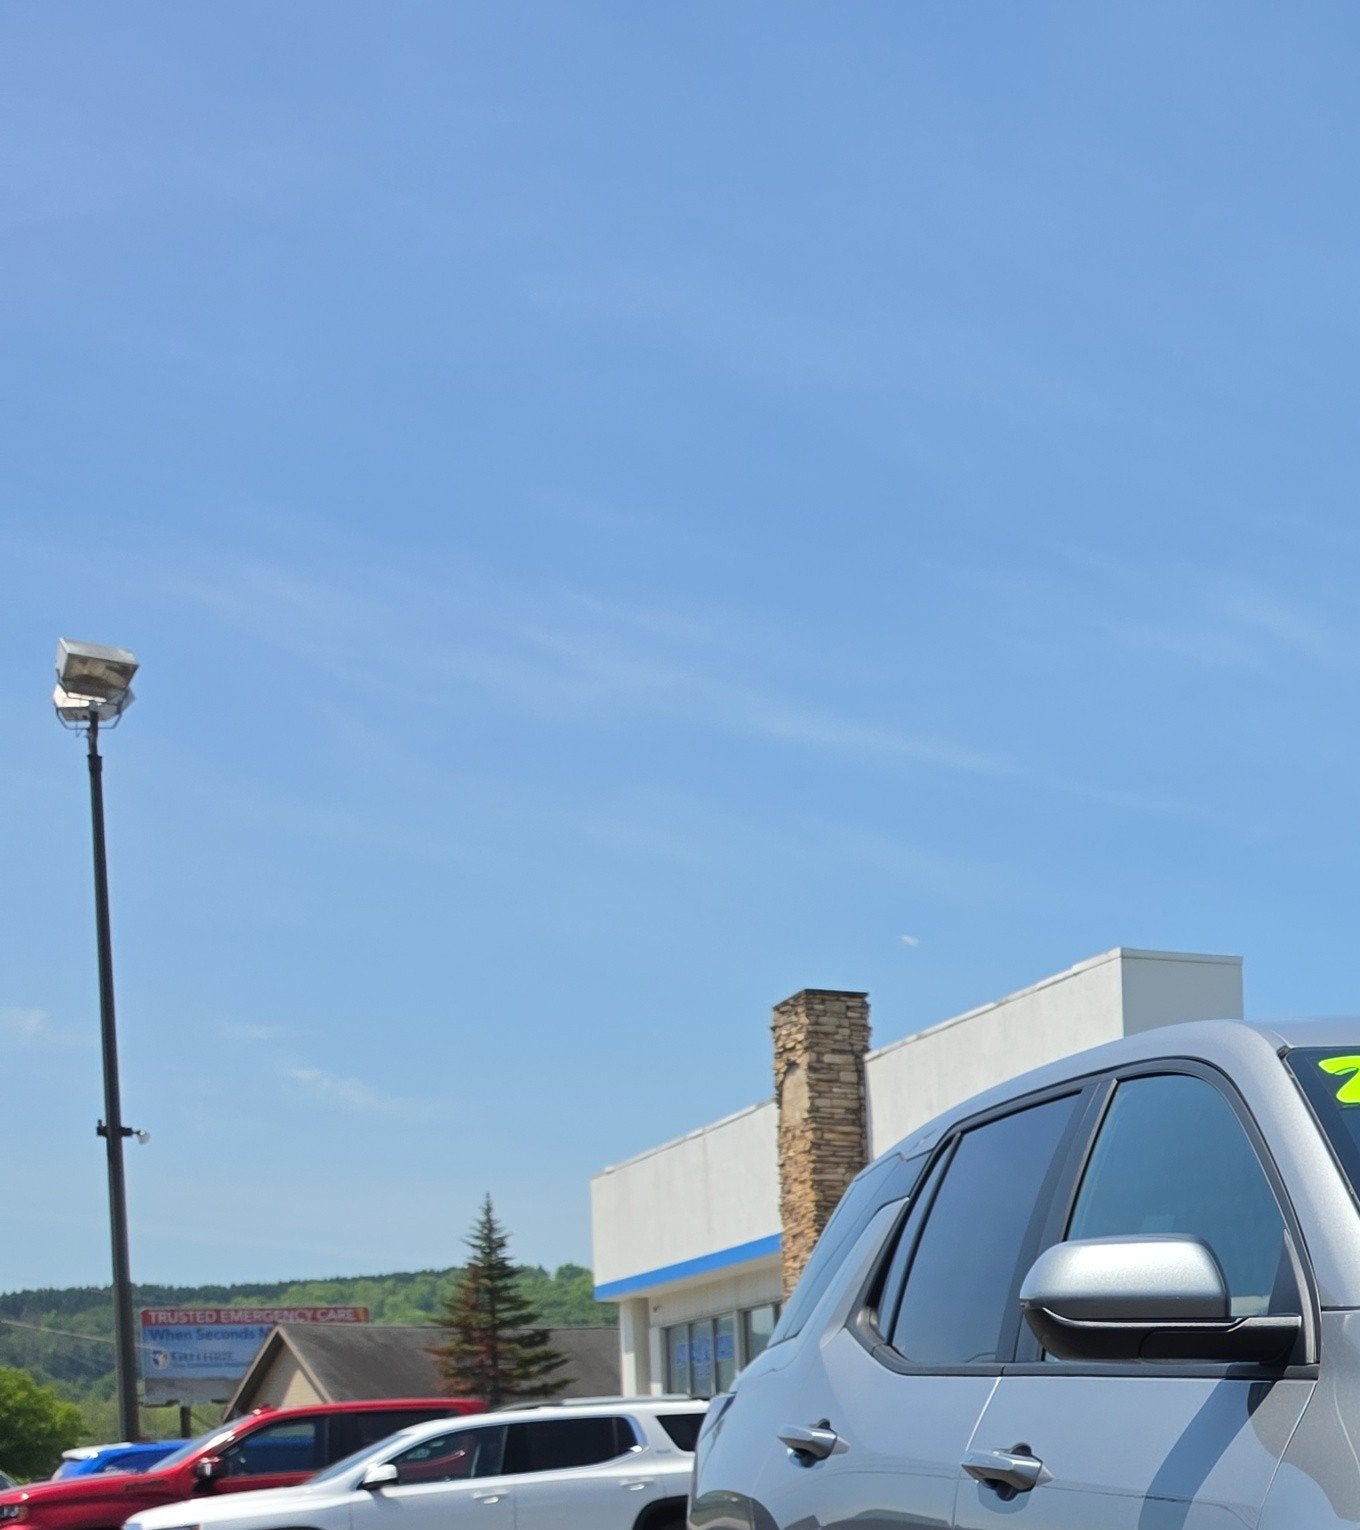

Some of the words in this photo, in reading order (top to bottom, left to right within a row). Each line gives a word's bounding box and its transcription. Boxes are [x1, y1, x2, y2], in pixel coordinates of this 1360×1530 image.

[149, 1310, 217, 1324] TRUSTED
[220, 1309, 313, 1324] EMERGENCY
[319, 1308, 356, 1322] CARE
[150, 1328, 193, 1341] When
[196, 1327, 255, 1341] Seconds
